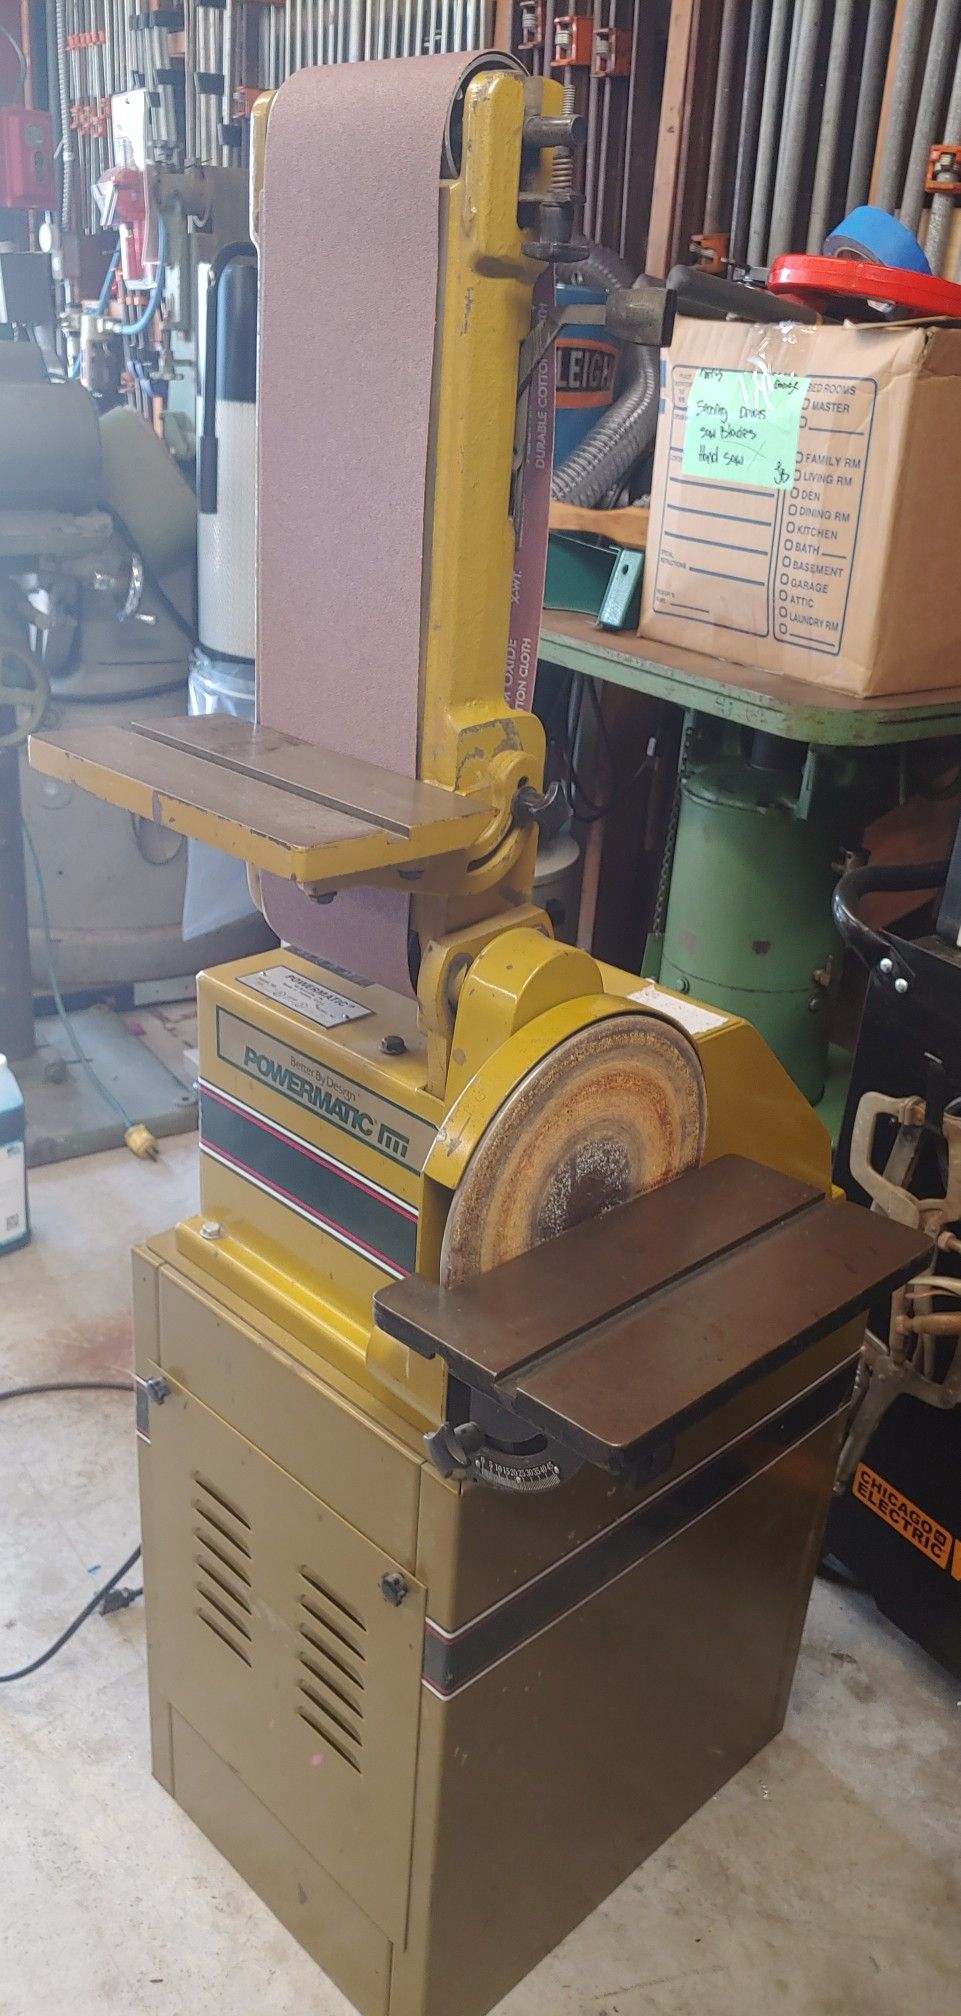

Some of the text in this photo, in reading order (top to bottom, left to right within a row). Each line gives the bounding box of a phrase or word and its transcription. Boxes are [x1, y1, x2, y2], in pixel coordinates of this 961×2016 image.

[812, 401, 850, 413] MASTER
[536, 411, 548, 469] DURABLE
[805, 453, 861, 469] FAMILY RM
[803, 470, 852, 486] LIVING RM
[801, 490, 820, 501] DEN
[799, 506, 850, 522] DINING RM
[796, 525, 838, 540] KITCHEN
[795, 542, 820, 556] BATH
[792, 560, 843, 577] BASEMENT
[790, 579, 829, 593] GARAGE
[790, 595, 814, 608] ATTIC
[789, 612, 838, 631] LAUNDRY RM
[504, 639, 517, 687] OXIDE
[519, 638, 532, 678] CLOTH
[285, 974, 348, 1007] POWERMATIC
[290, 1056, 356, 1102] Better By Design
[243, 1045, 374, 1137] POWERMATIC
[861, 1470, 933, 1535] CHICAGO
[857, 1481, 943, 1559] ELECTRIC
